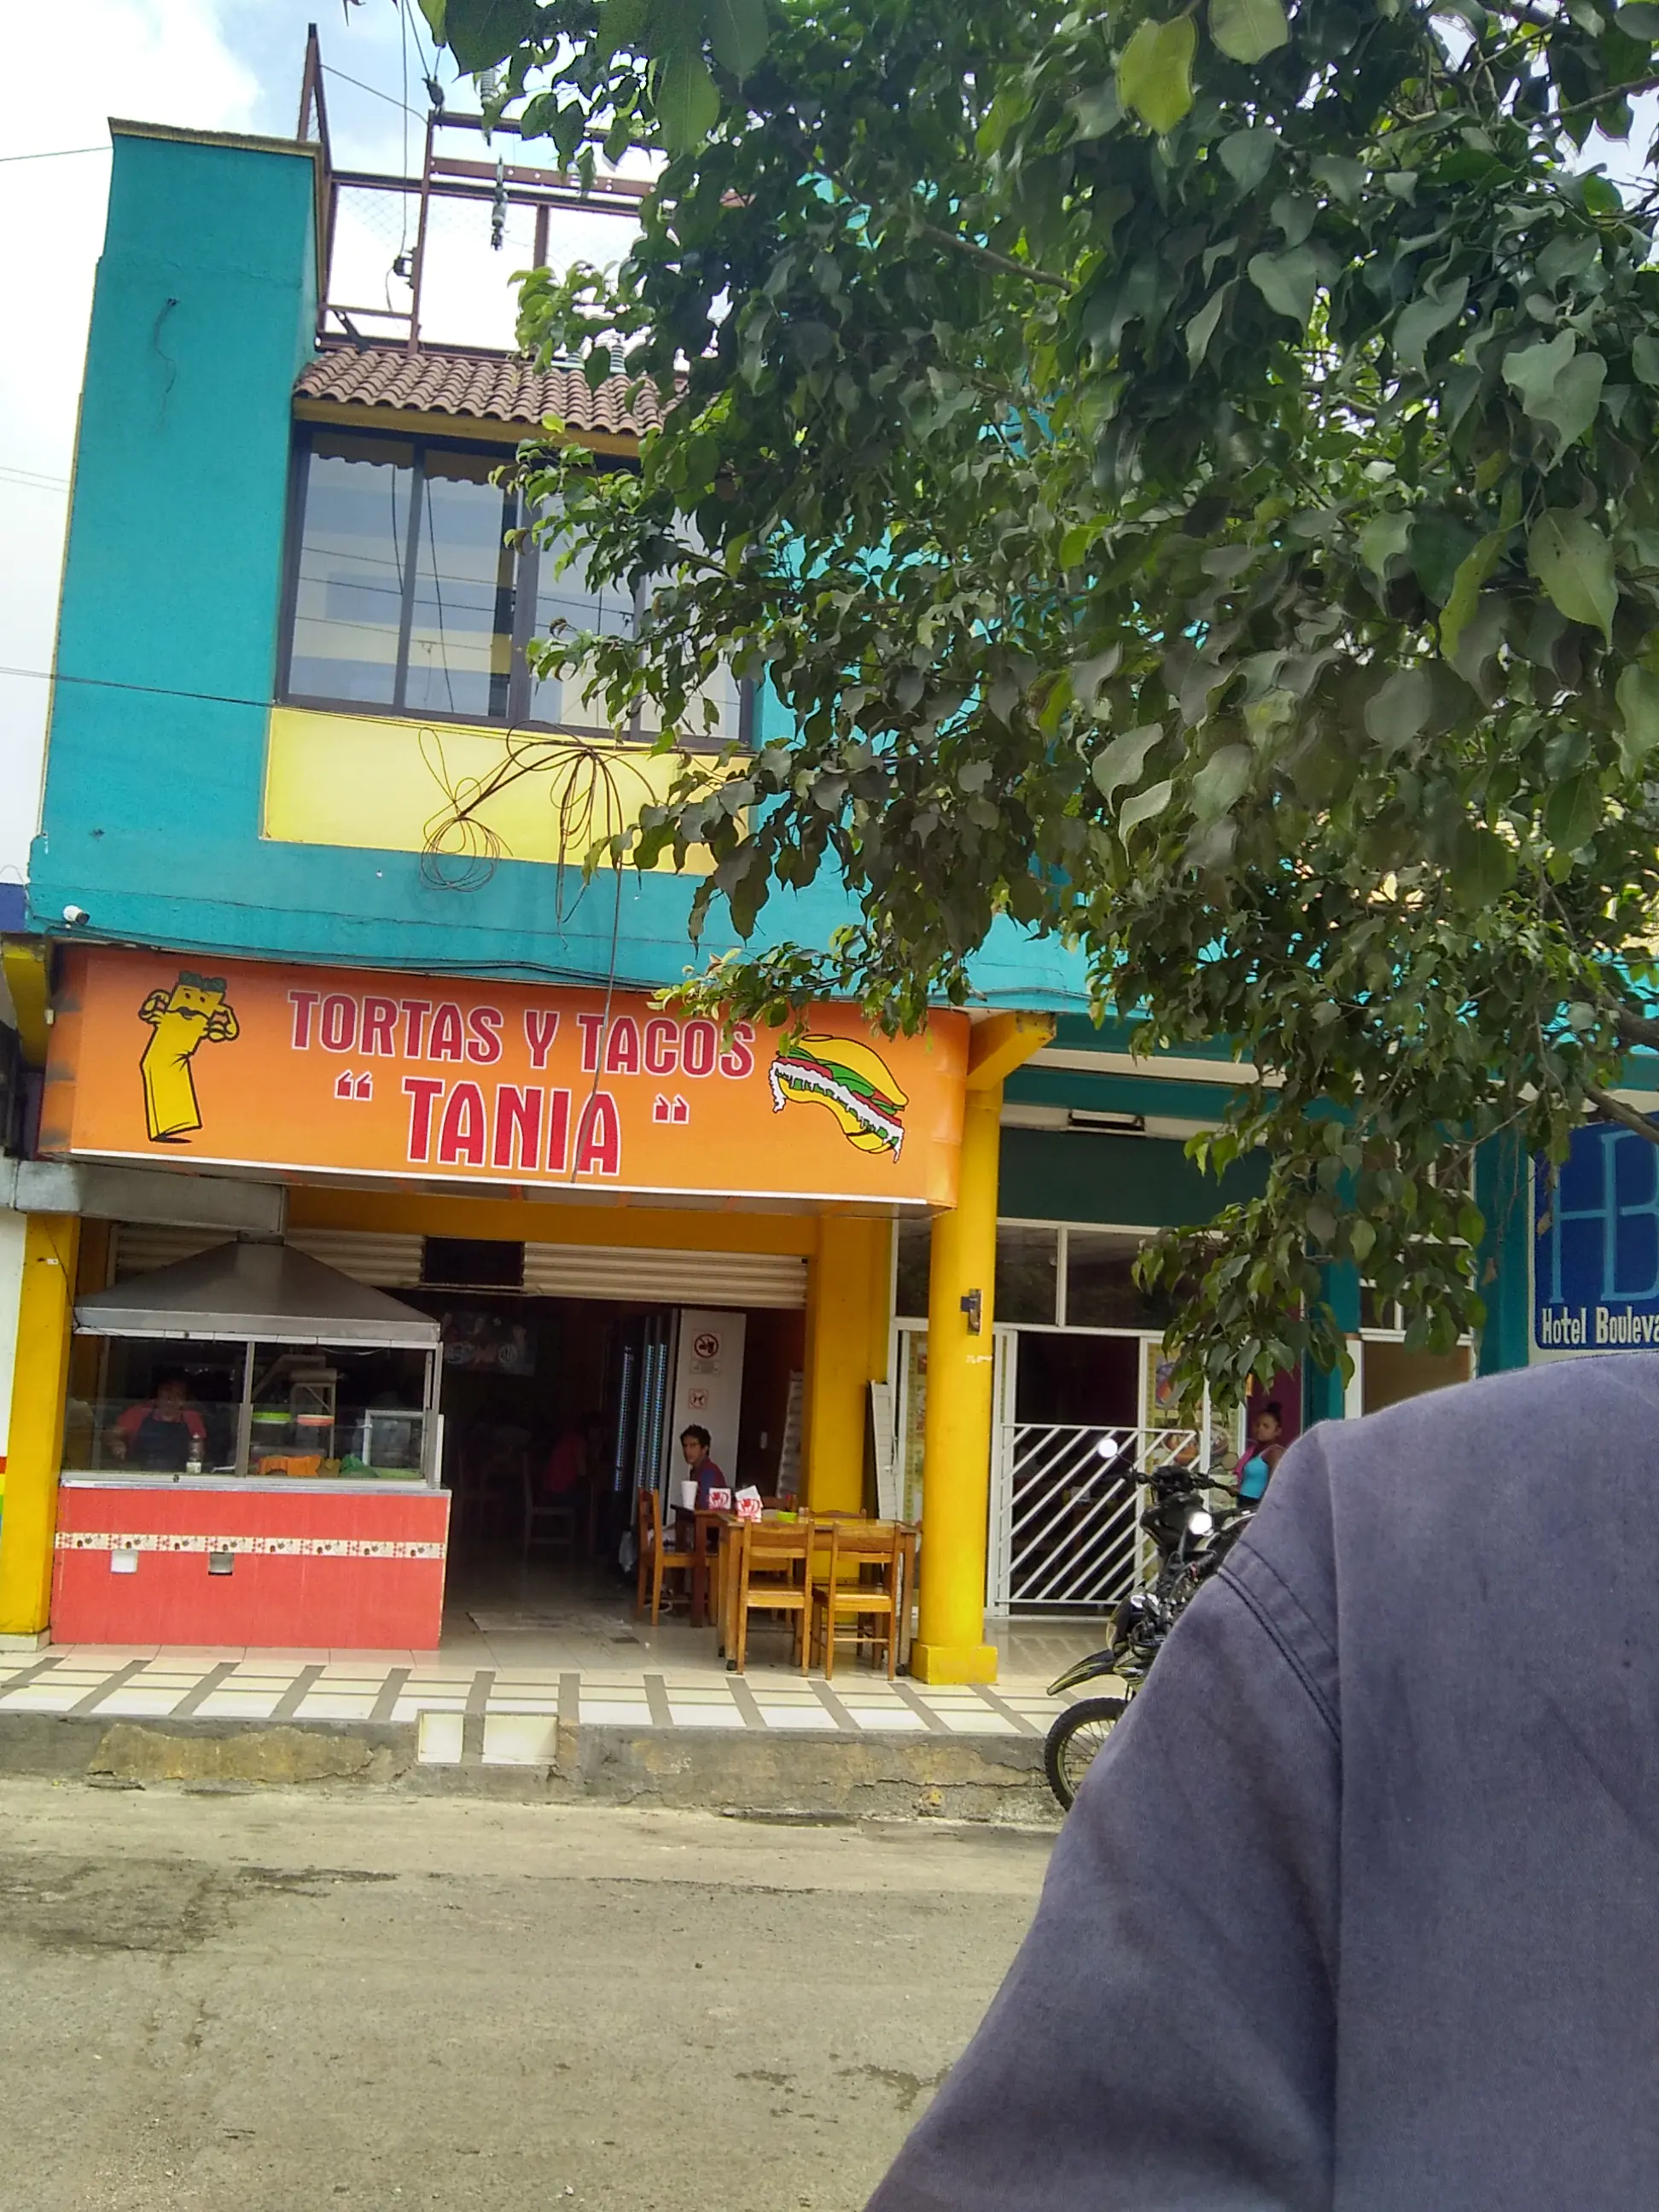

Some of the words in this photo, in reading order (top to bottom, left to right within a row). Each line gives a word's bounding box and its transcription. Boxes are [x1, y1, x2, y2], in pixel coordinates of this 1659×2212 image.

[288, 990, 504, 1066] TORTAS
[524, 1010, 560, 1068] Y
[576, 1013, 755, 1080] TACOS
[402, 1075, 621, 1177] TANIA
[1542, 1306, 1587, 1344] Hotel
